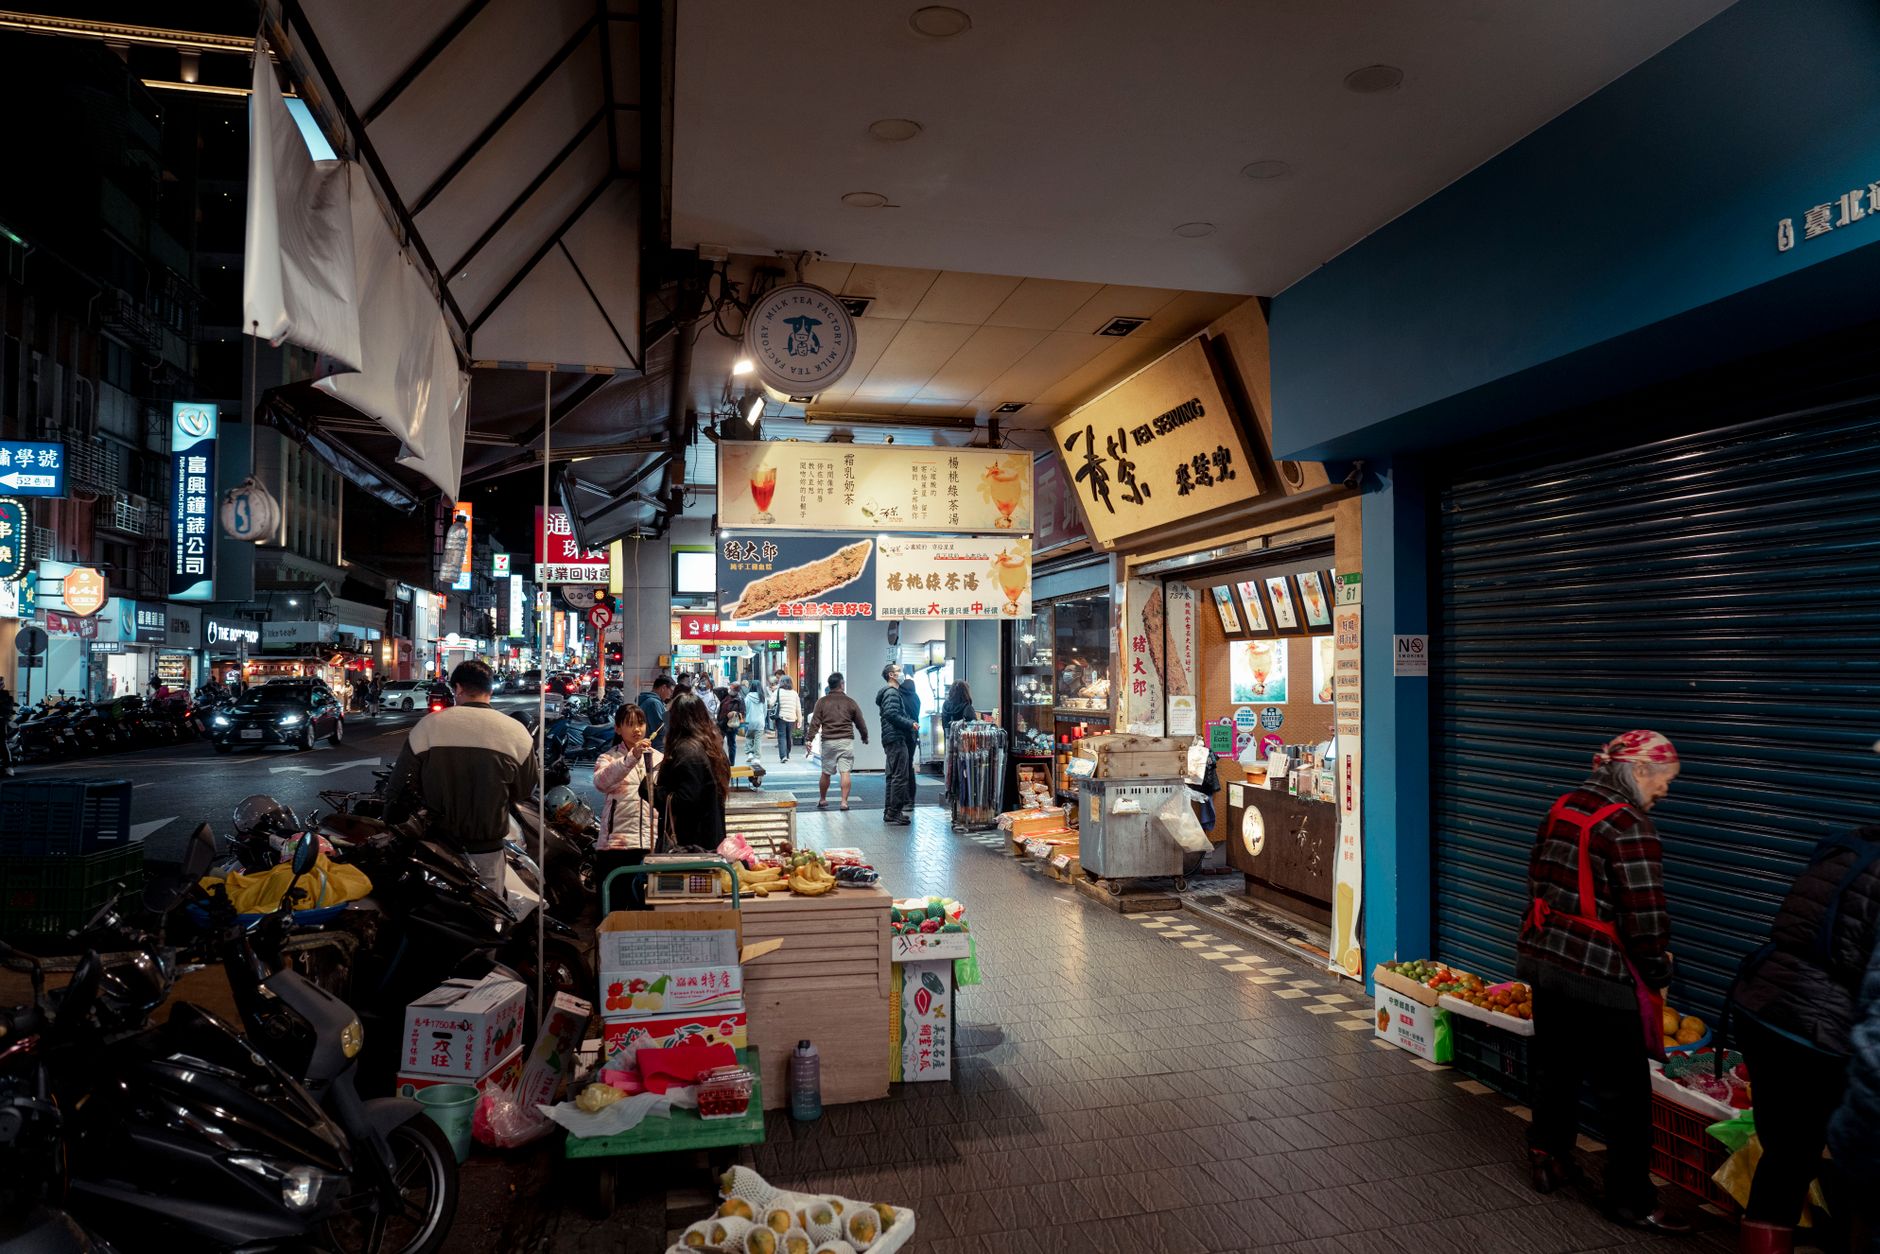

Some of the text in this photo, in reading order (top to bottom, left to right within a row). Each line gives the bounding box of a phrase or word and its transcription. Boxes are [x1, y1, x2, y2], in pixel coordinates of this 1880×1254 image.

[766, 296, 841, 346] MILK TEA FACTORY
[761, 325, 837, 375] MILK TEA FACTORY
[1130, 397, 1205, 446] TEA SERVING
[843, 454, 855, 506] 霜乳奶茶
[947, 456, 959, 526] 楊桃綠茶湯
[185, 456, 207, 575] 富興鐘錶公司
[887, 571, 980, 591] 楊桃綠茶湯
[1346, 586, 1356, 600] 61
[218, 626, 230, 640] THE
[777, 603, 873, 617] 全台最大最好吃
[1132, 636, 1148, 697] 豬大郎
